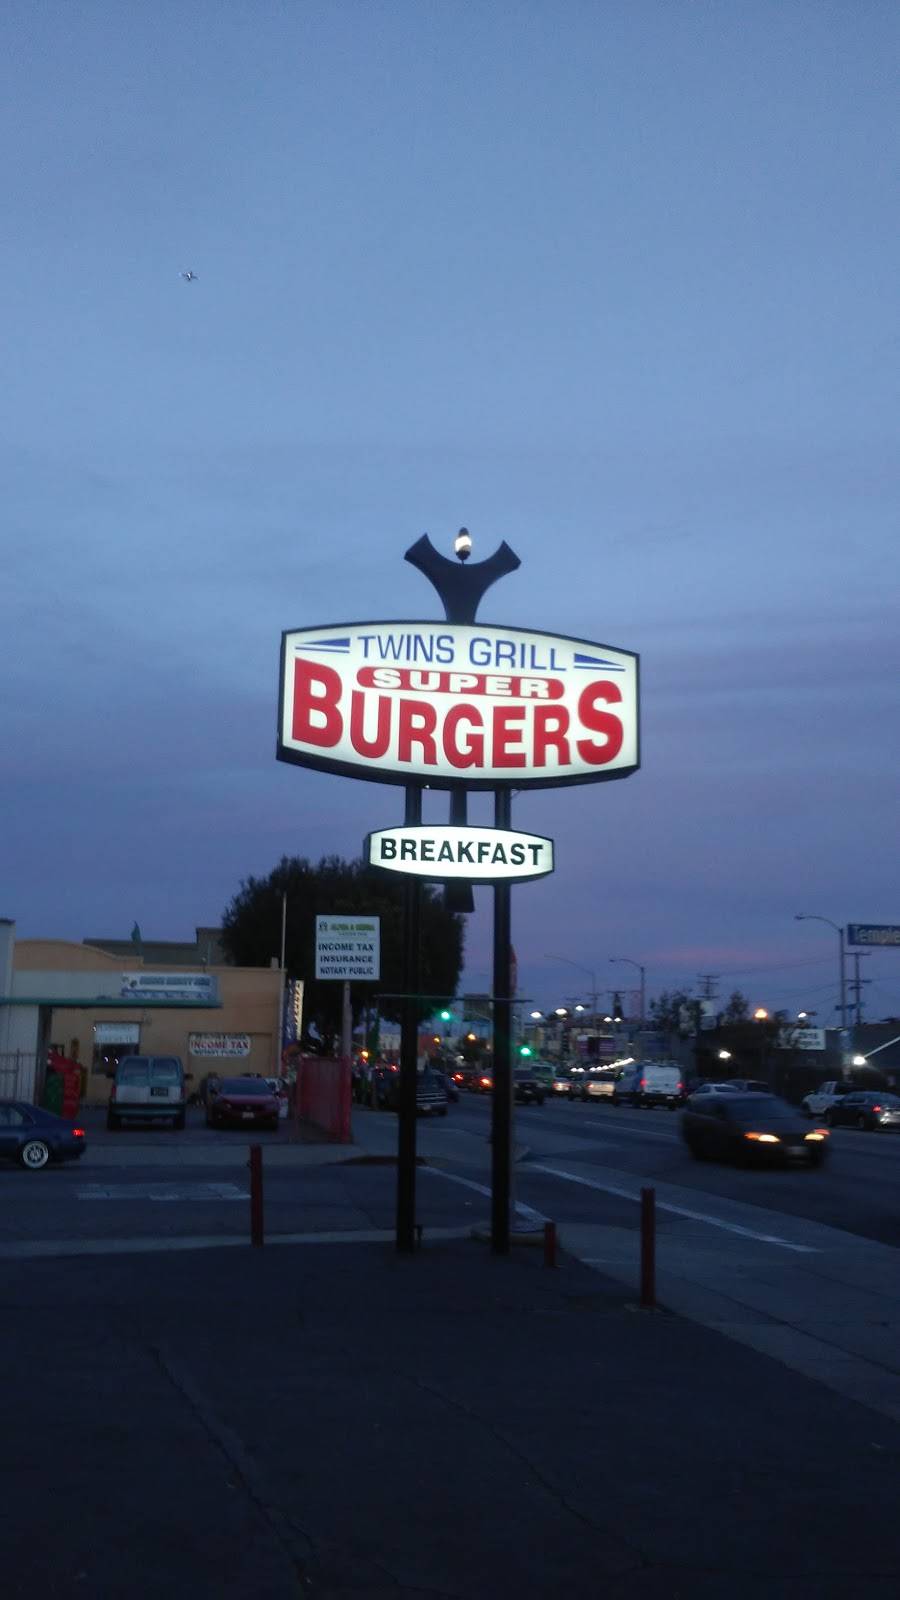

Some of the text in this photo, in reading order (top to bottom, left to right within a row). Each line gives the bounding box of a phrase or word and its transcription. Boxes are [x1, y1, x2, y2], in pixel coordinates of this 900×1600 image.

[357, 634, 567, 672] TWINS GRILL
[372, 667, 550, 698] SUPER
[292, 657, 624, 769] BURGERS
[380, 837, 544, 866] BREAKFAST
[318, 943, 375, 952] INCOME TAX
[320, 955, 373, 963] INSURANCE
[320, 967, 374, 975] NOTARY PUBLIC
[191, 1040, 249, 1049] INCOME TAX
